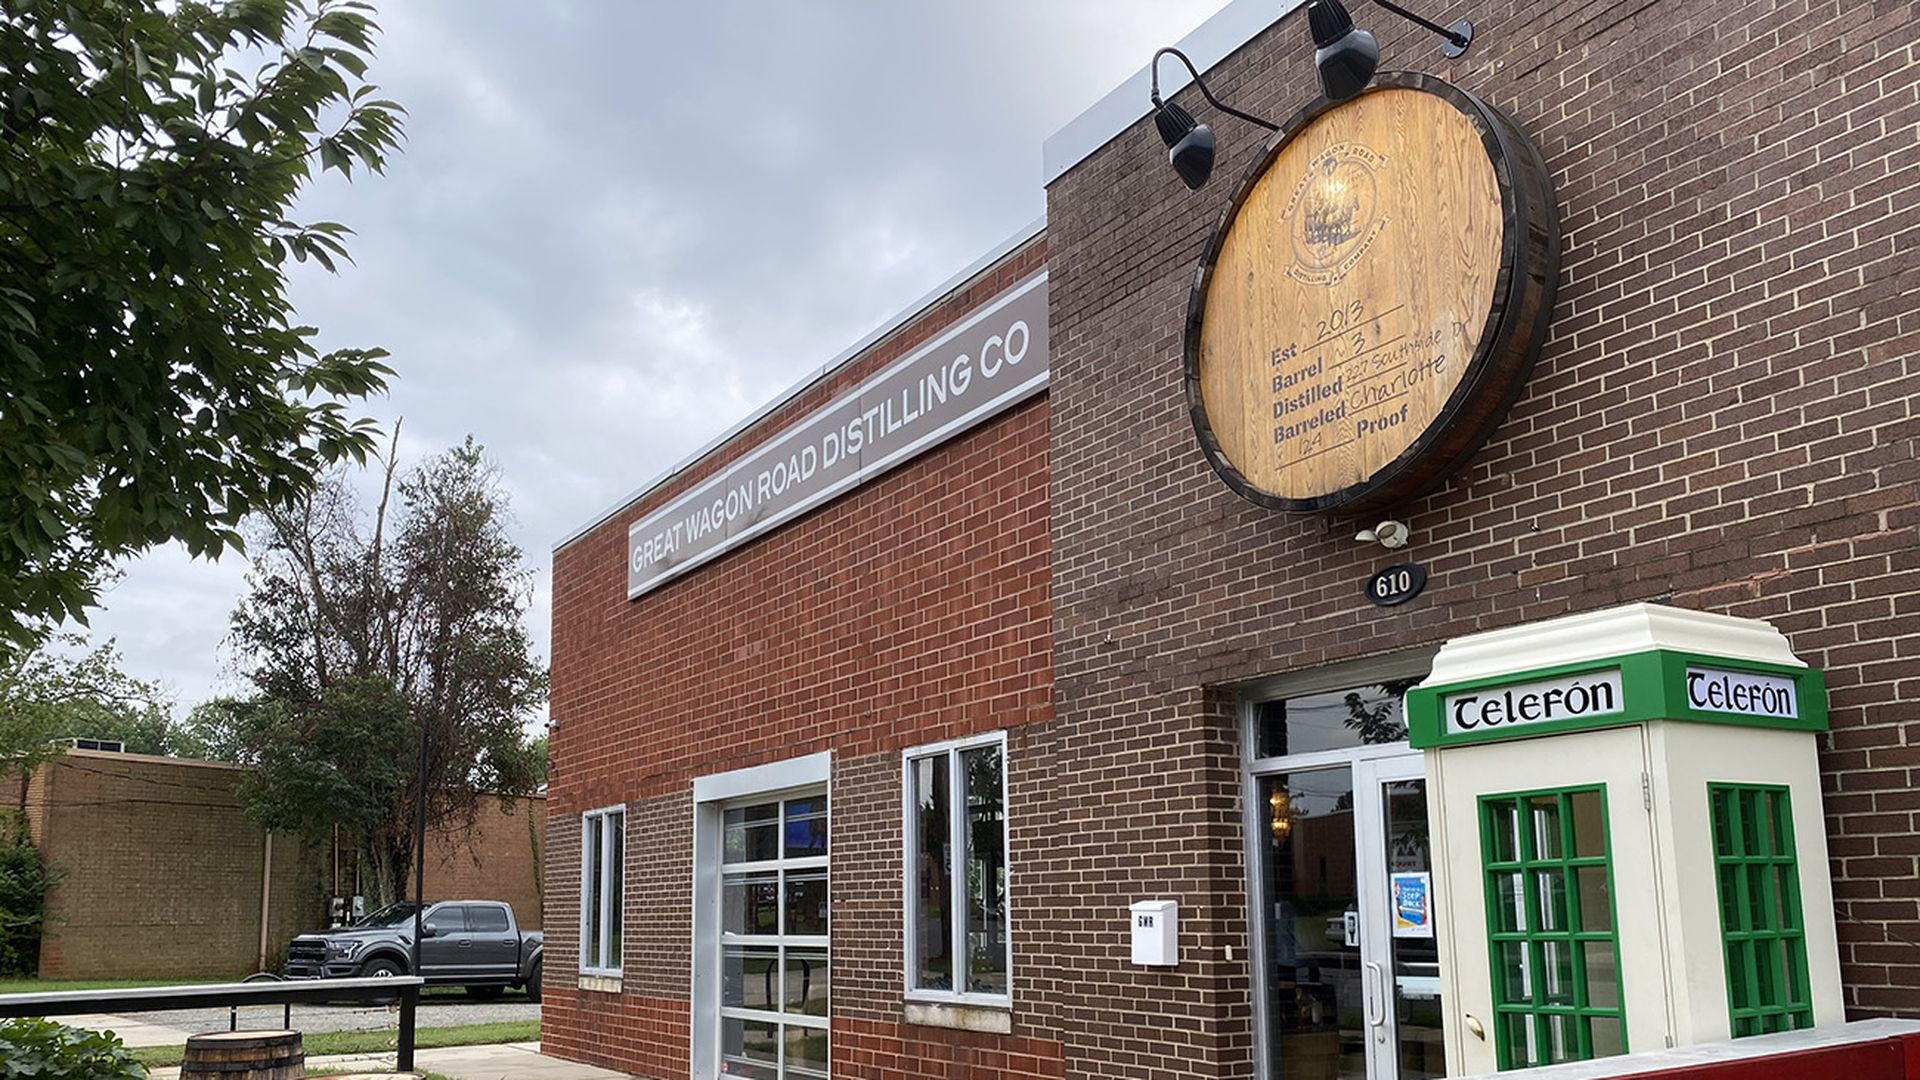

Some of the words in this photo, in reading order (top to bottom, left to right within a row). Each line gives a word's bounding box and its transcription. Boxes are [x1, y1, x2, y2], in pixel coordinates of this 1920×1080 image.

[1311, 144, 1345, 167] WAGON
[1352, 147, 1375, 163] ROAD
[1343, 230, 1377, 270] COMPANY
[1271, 342, 1298, 367] Est
[1316, 299, 1364, 341] 2013
[1272, 356, 1323, 394] Barrel
[1350, 331, 1365, 355] 3
[1272, 375, 1343, 419] Distilled
[1346, 359, 1369, 383] 227
[1273, 400, 1346, 444] Barreled
[1349, 354, 1446, 410] Charlotte
[632, 520, 684, 574] GREAT
[686, 480, 753, 544] WAGON
[758, 444, 817, 505] ROAD
[822, 353, 972, 470] DISTILLING
[979, 319, 1030, 379] CO
[1356, 403, 1408, 440] Proof
[1375, 570, 1411, 598] 610
[1453, 680, 1614, 730] Telefón
[1687, 671, 1792, 715] Telefón
